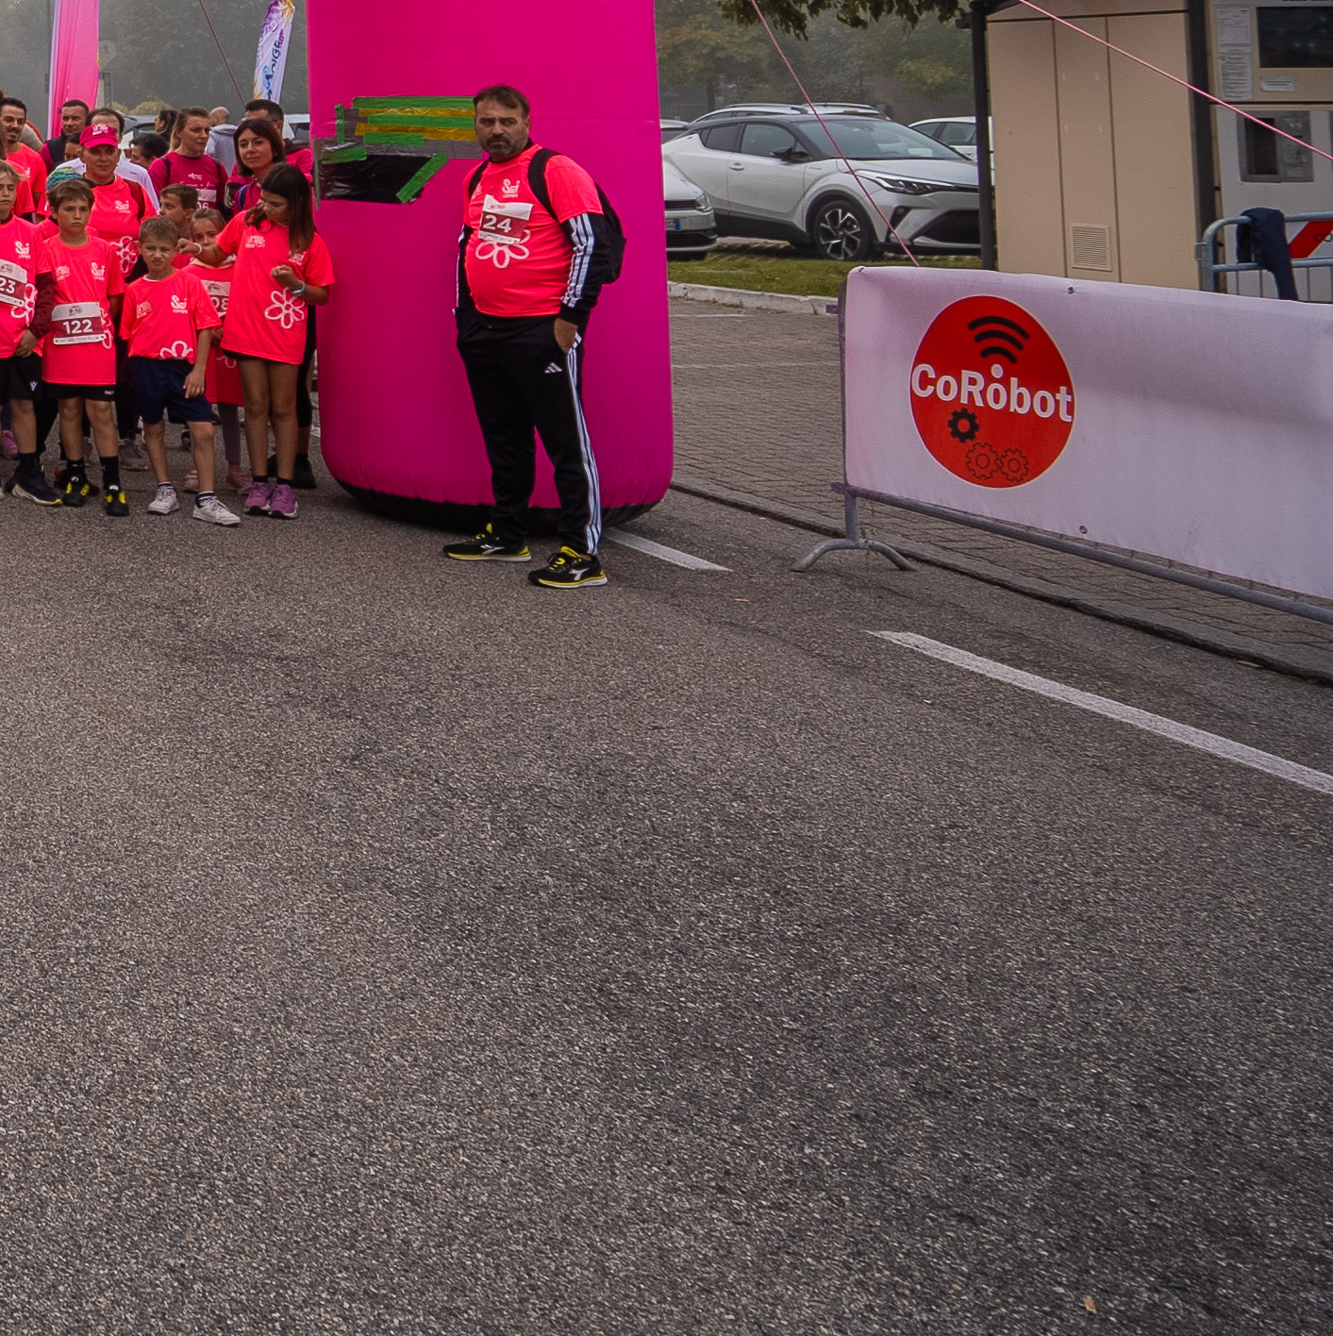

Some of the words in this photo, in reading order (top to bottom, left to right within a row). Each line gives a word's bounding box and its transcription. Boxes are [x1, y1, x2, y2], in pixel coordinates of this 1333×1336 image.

[482, 214, 512, 233] 24
[63, 319, 93, 335] 122
[911, 363, 1073, 422] CoRobot
